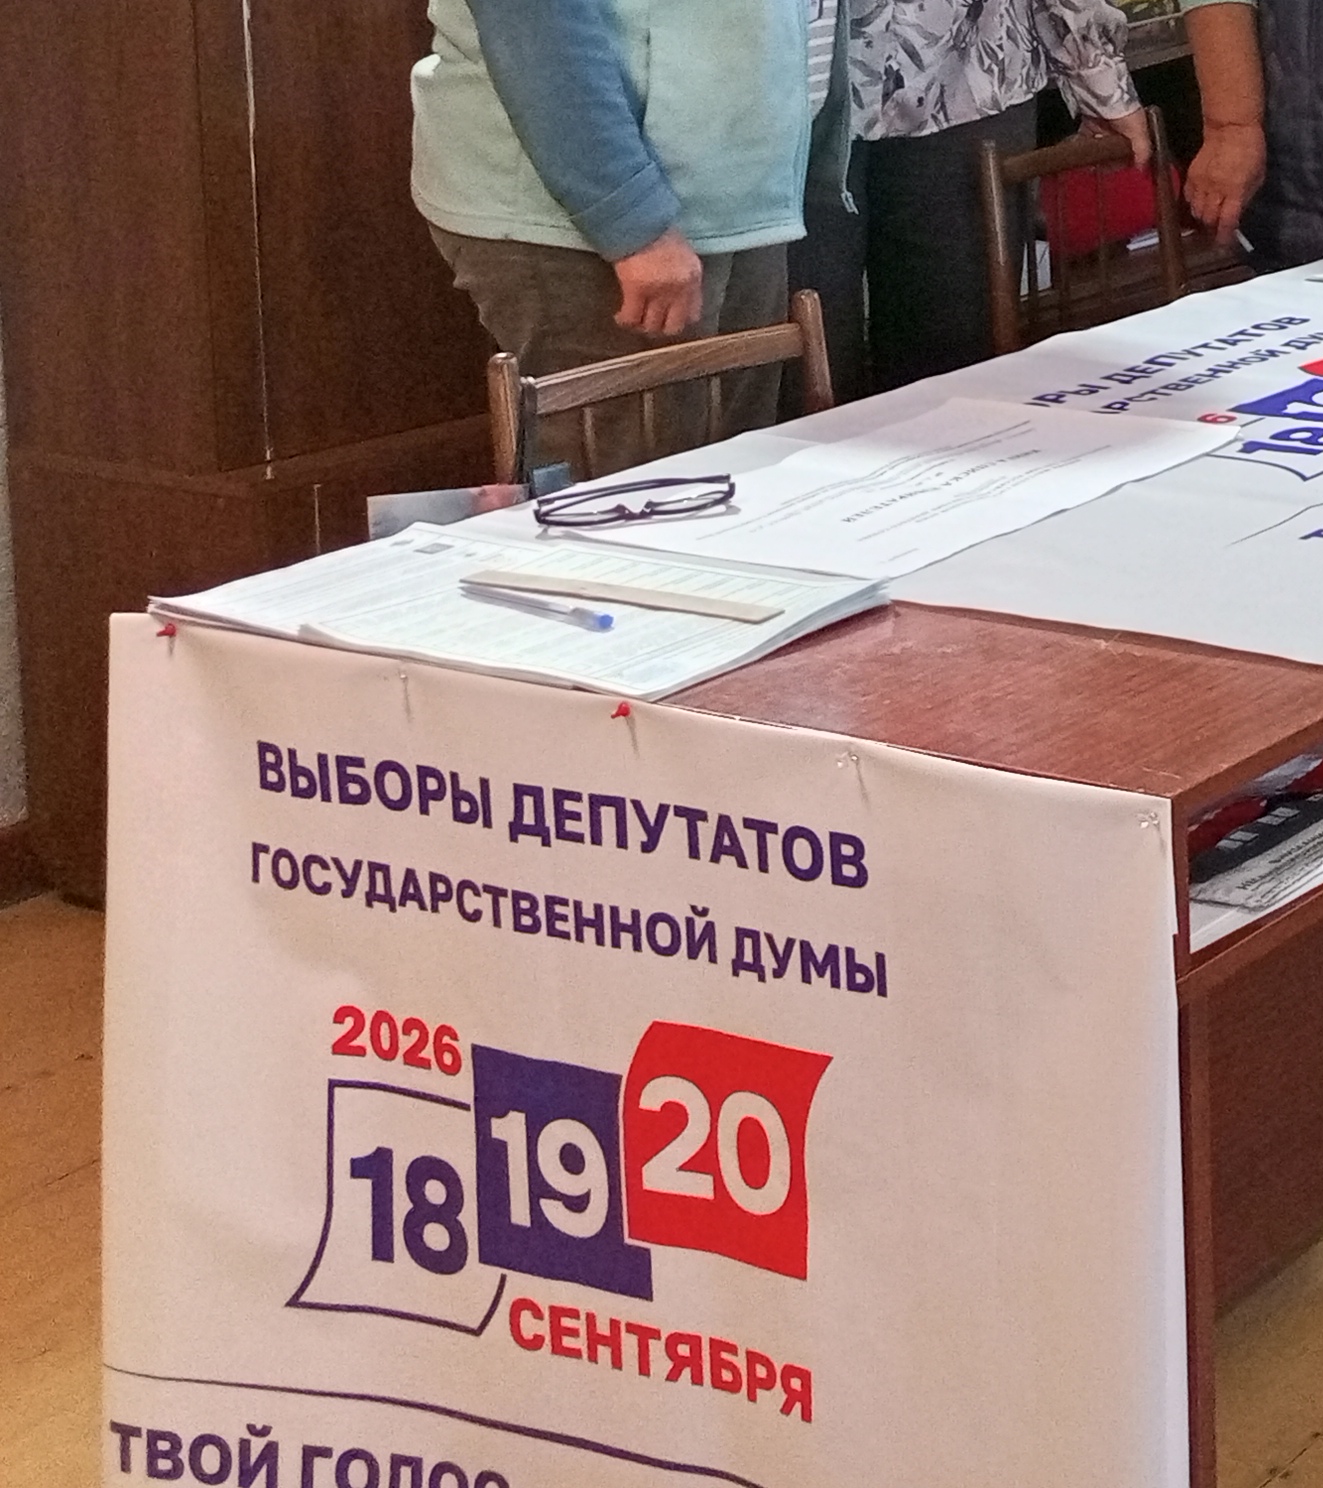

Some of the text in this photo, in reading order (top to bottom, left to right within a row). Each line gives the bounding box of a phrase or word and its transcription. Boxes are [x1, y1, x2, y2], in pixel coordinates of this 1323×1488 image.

[1091, 347, 1288, 414] РСТВЕННОЙ
[1100, 315, 1311, 385] ДЕПУТАТОВ
[257, 740, 870, 889] ВЫБОРЫ ДЕПУТАТОВ
[251, 841, 888, 998] ГОСУДАРСТВЕННОЙ ДУМЫ
[331, 1005, 462, 1075] 2026
[350, 1074, 791, 1275] 18 19 20
[509, 1297, 813, 1423] СЕНТЯБРЯ
[110, 1419, 279, 1488] ТВОЙ
